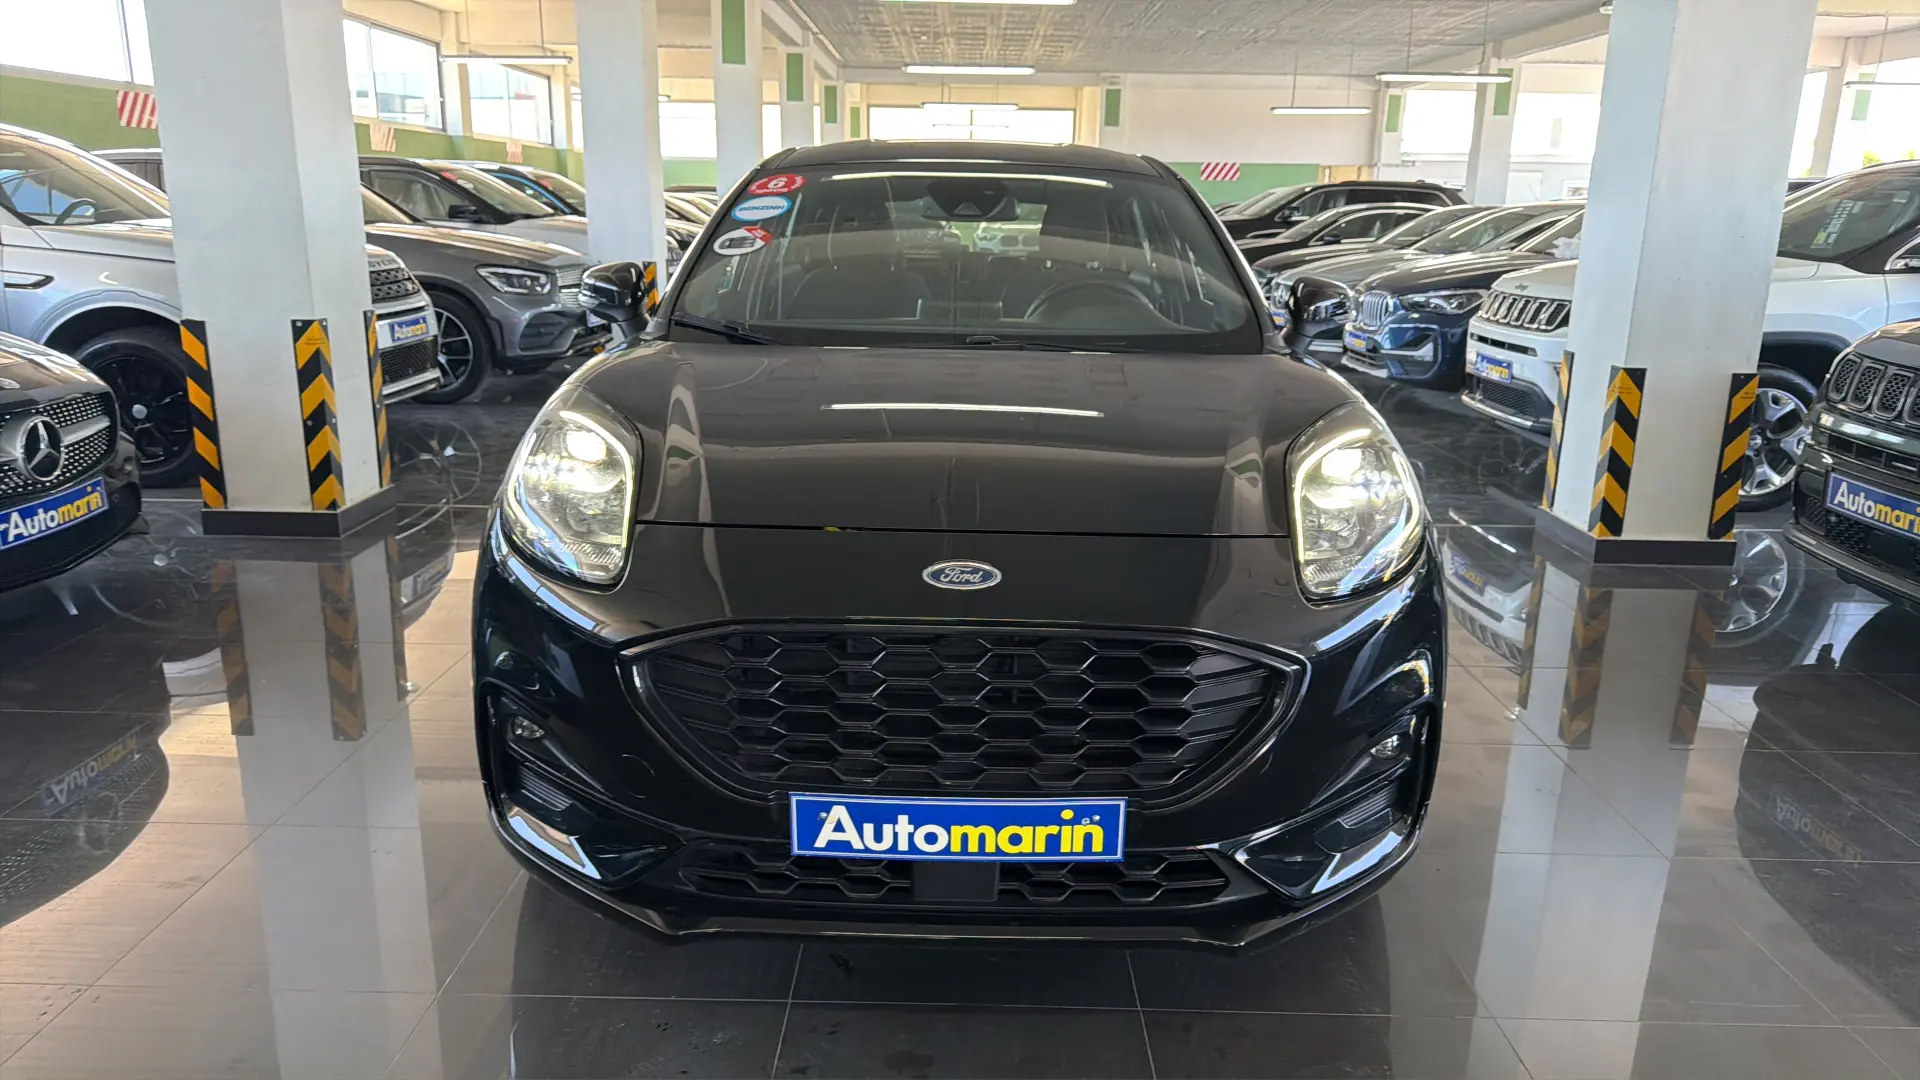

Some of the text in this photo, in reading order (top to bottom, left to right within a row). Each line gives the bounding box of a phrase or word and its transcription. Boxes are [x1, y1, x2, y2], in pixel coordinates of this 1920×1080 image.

[767, 177, 788, 189] 6
[8, 486, 103, 542] Automarin
[1833, 481, 1920, 534] Automari
[940, 566, 984, 582] Ford
[813, 804, 1104, 854] Automarin
